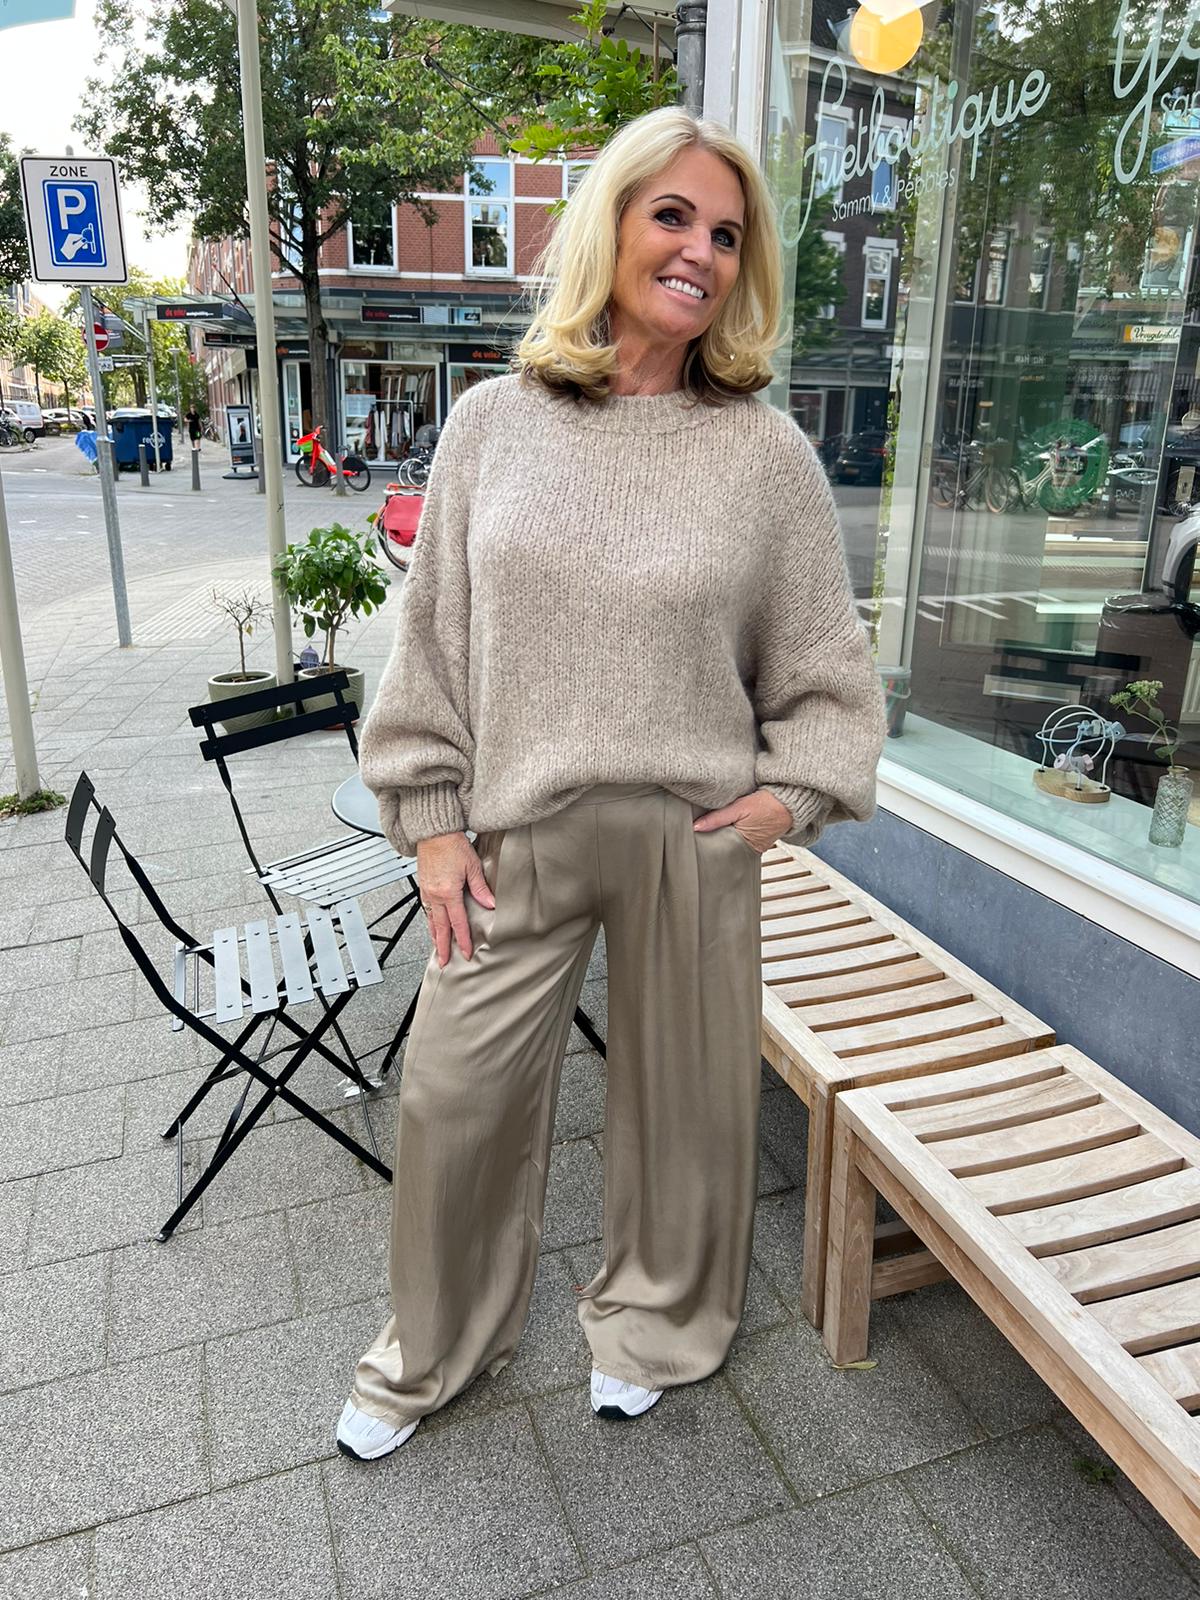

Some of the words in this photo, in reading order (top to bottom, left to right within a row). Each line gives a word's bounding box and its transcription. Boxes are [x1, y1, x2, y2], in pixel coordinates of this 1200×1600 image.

[50, 165, 88, 178] ZONE
[57, 188, 86, 230] P
[831, 191, 879, 222] Sammy
[881, 185, 892, 207] &
[896, 167, 956, 202] Pebbles
